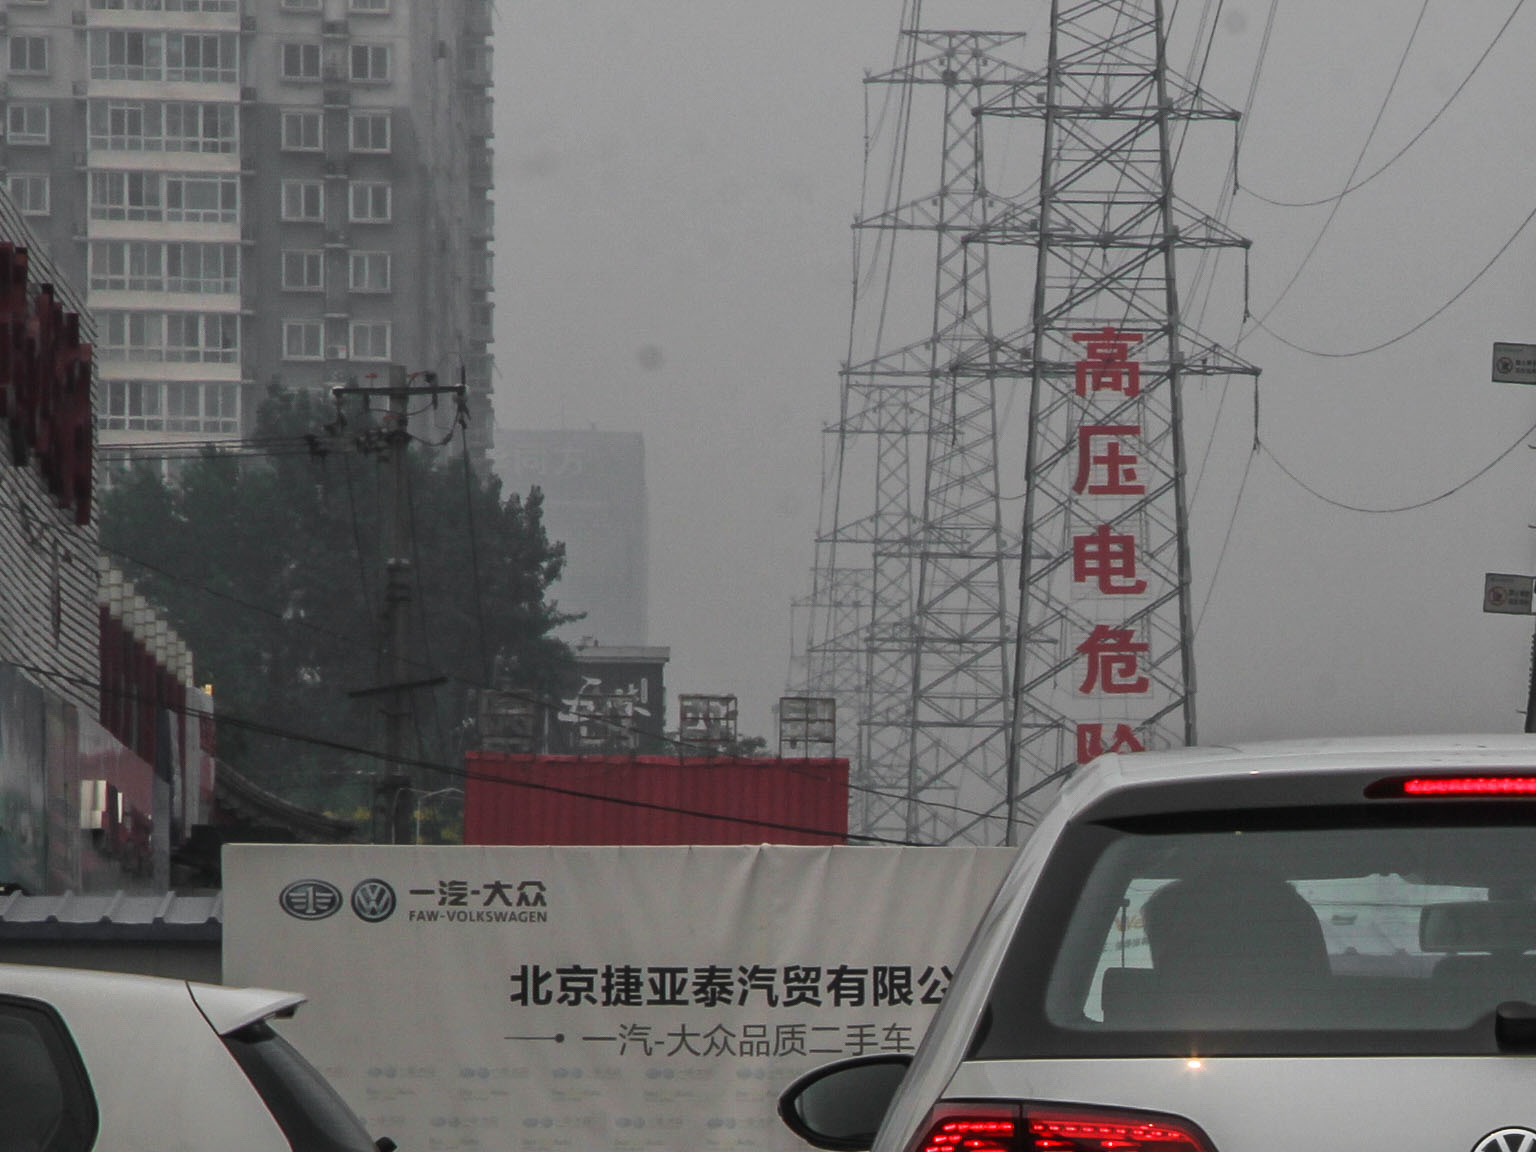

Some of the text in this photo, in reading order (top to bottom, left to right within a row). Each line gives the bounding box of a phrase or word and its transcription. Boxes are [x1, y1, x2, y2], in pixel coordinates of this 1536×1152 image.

[409, 880, 547, 907] 一汽-大众
[408, 910, 548, 923] FAW-VOLKSWAGEN
[510, 964, 954, 1007] 北京捷亚泰汽贸有限公
[581, 1023, 916, 1057] 一汽-大众品质二手车
